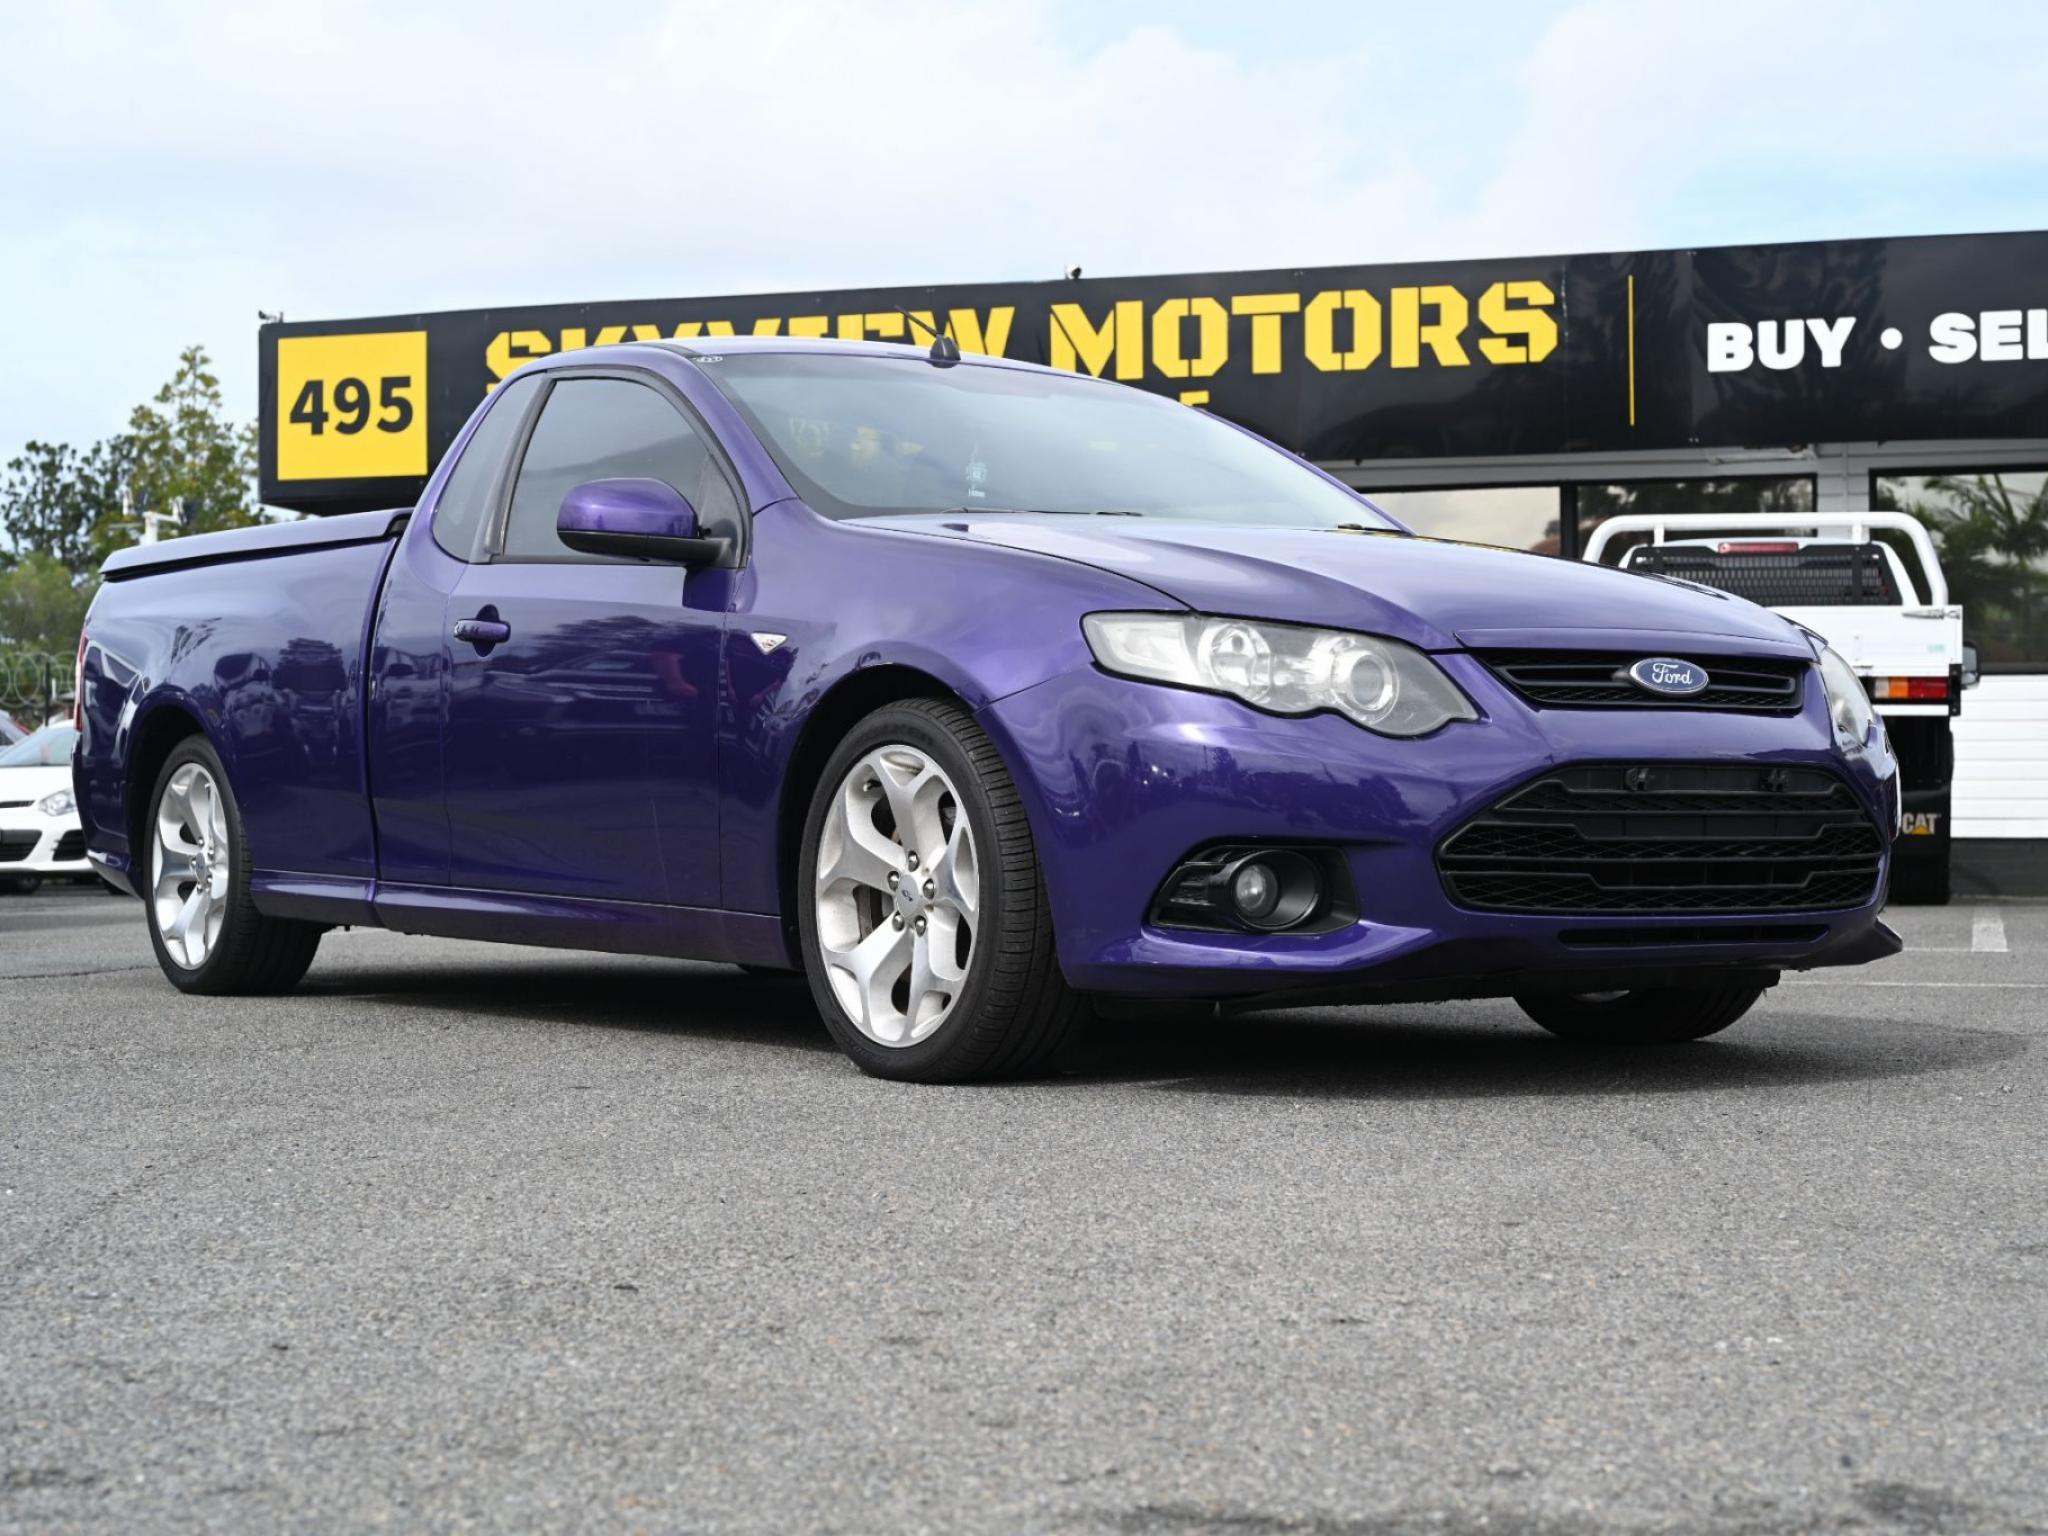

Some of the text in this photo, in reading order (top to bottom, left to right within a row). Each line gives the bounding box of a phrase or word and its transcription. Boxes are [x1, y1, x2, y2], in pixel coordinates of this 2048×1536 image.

[1050, 281, 1558, 381] MOTORS
[1707, 317, 1857, 373] BUY
[289, 376, 413, 436] 495
[1651, 662, 1693, 685] Ford
[1902, 813, 1936, 835] CAT
